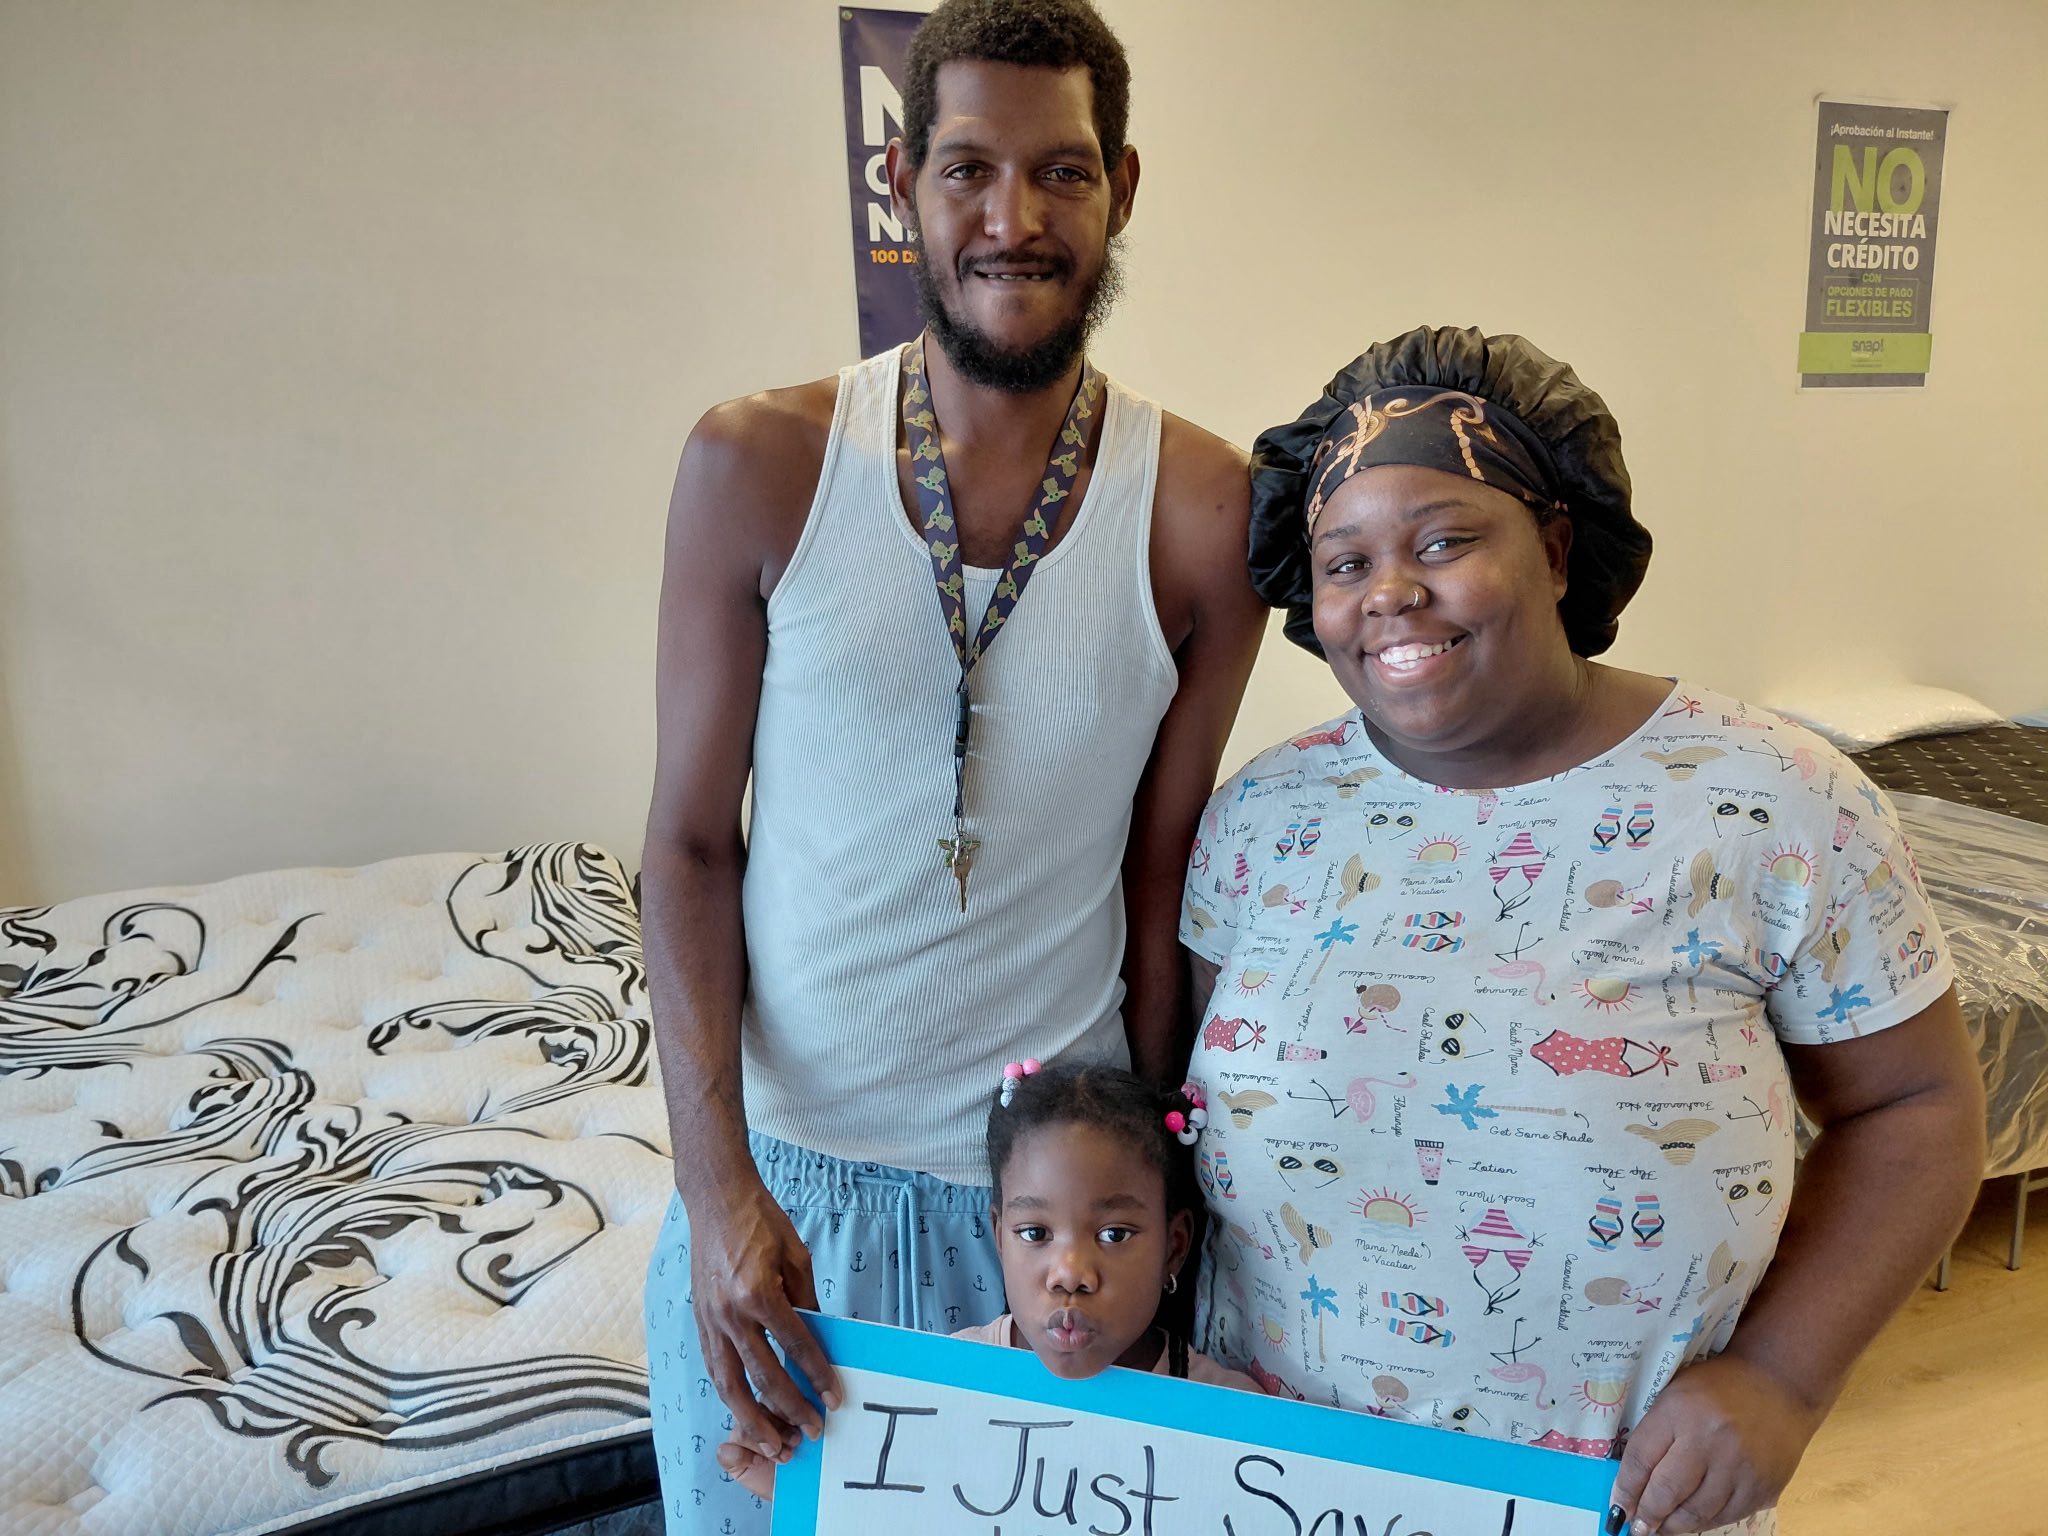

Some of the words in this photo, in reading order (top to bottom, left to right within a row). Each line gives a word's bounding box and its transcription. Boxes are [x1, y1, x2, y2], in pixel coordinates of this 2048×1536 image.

[1830, 123, 1884, 137] ¡Aprobación
[1886, 128, 1894, 138] al
[1896, 128, 1934, 140] Instante!
[1830, 144, 1926, 216] NO
[1824, 210, 1927, 239] NECESITA
[870, 250, 898, 263] 100
[1827, 237, 1919, 271] CRÉDITO
[1862, 273, 1882, 283] CON
[1828, 286, 1873, 297] OPCIONES
[1875, 288, 1887, 297] DE
[1889, 288, 1913, 298] PAGO
[1826, 299, 1912, 318] FLEXIBLES
[1852, 339, 1884, 354] snap!
[1489, 1126, 1511, 1138] Get
[1514, 1127, 1550, 1140] Some
[1553, 1130, 1594, 1144] Shade
[1468, 1161, 1517, 1175] Lotion
[1629, 1167, 1658, 1181] Flip
[1455, 1190, 1496, 1204] Mama
[1499, 1193, 1536, 1208] Beach
[1355, 1238, 1388, 1253] Mama
[1391, 1244, 1423, 1259] Needs
[1372, 1255, 1416, 1272] Vacation
[843, 1402, 938, 1493] I
[952, 1419, 1179, 1536] Just
